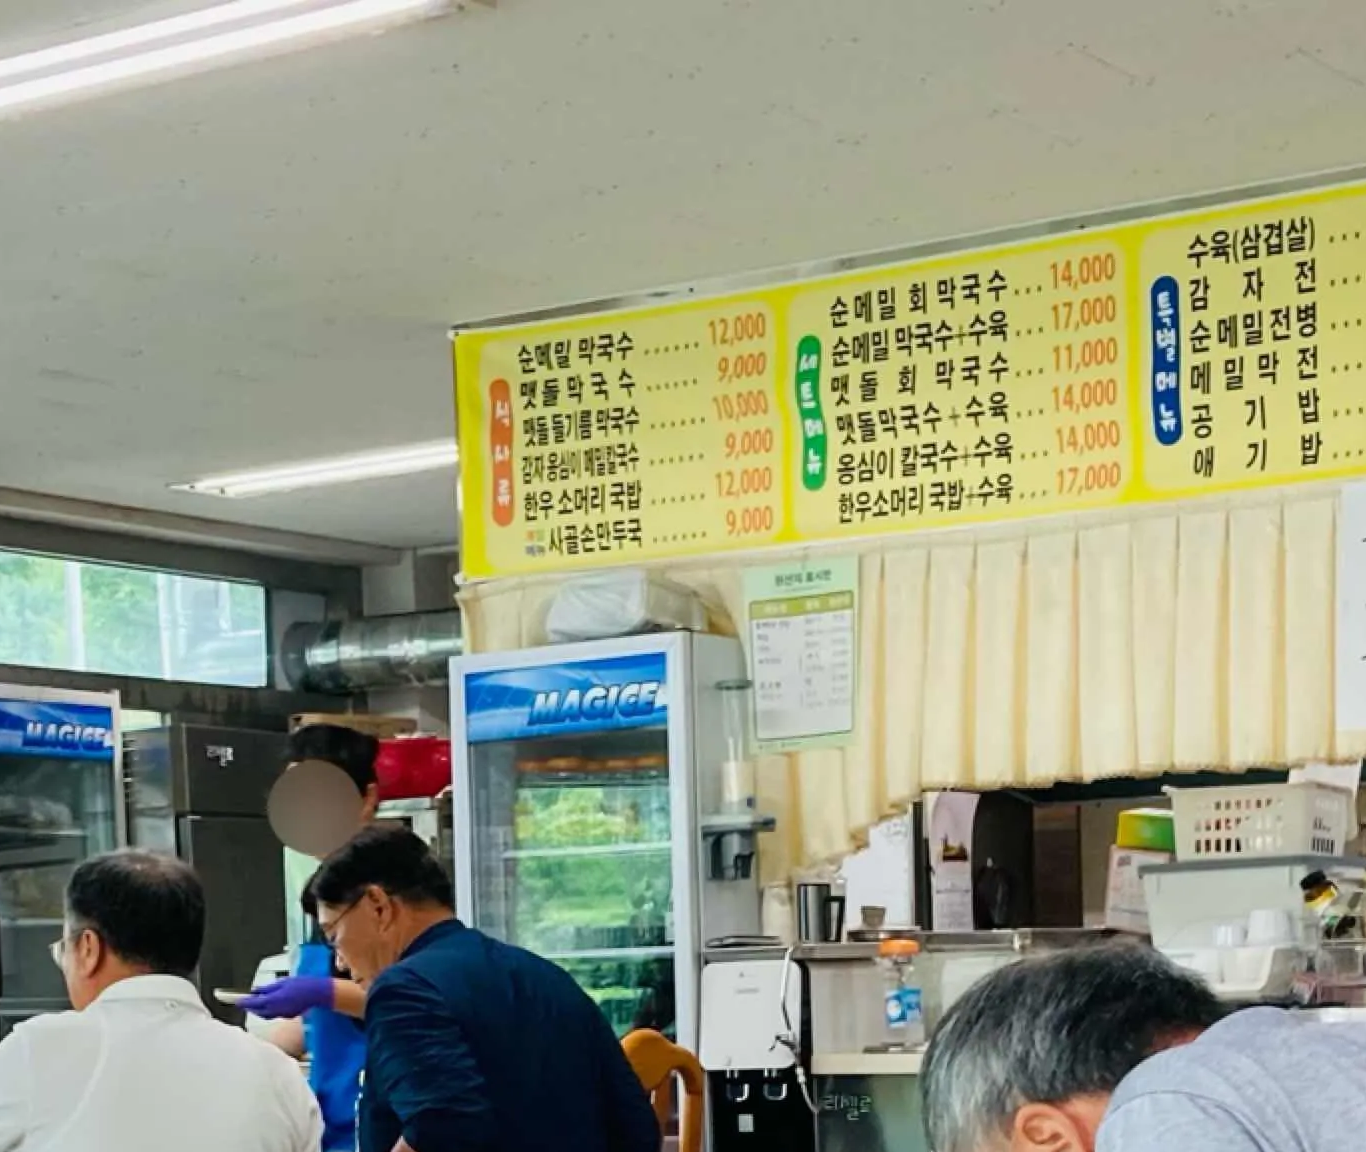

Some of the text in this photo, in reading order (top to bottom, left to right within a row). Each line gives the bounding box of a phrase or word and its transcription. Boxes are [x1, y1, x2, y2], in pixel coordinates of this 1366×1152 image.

[830, 253, 1115, 329] 순메밀 회 막국수 14,000
[517, 313, 765, 375] 순메밀 막국수 12,000
[831, 328, 889, 367] 순메밀
[1052, 295, 1115, 330] 17,000
[718, 353, 766, 382] 9,000
[936, 351, 1009, 390] 막국수
[1053, 337, 1117, 372] 11,000
[1155, 292, 1177, 432] 특별메뉴
[713, 391, 768, 420] 10,000
[1052, 378, 1117, 413] 14,000
[725, 430, 773, 457] 9,000
[1056, 420, 1120, 454] 14,000
[716, 467, 772, 497] 12,000
[1056, 462, 1121, 495] 17,000
[727, 506, 772, 536] 9,000
